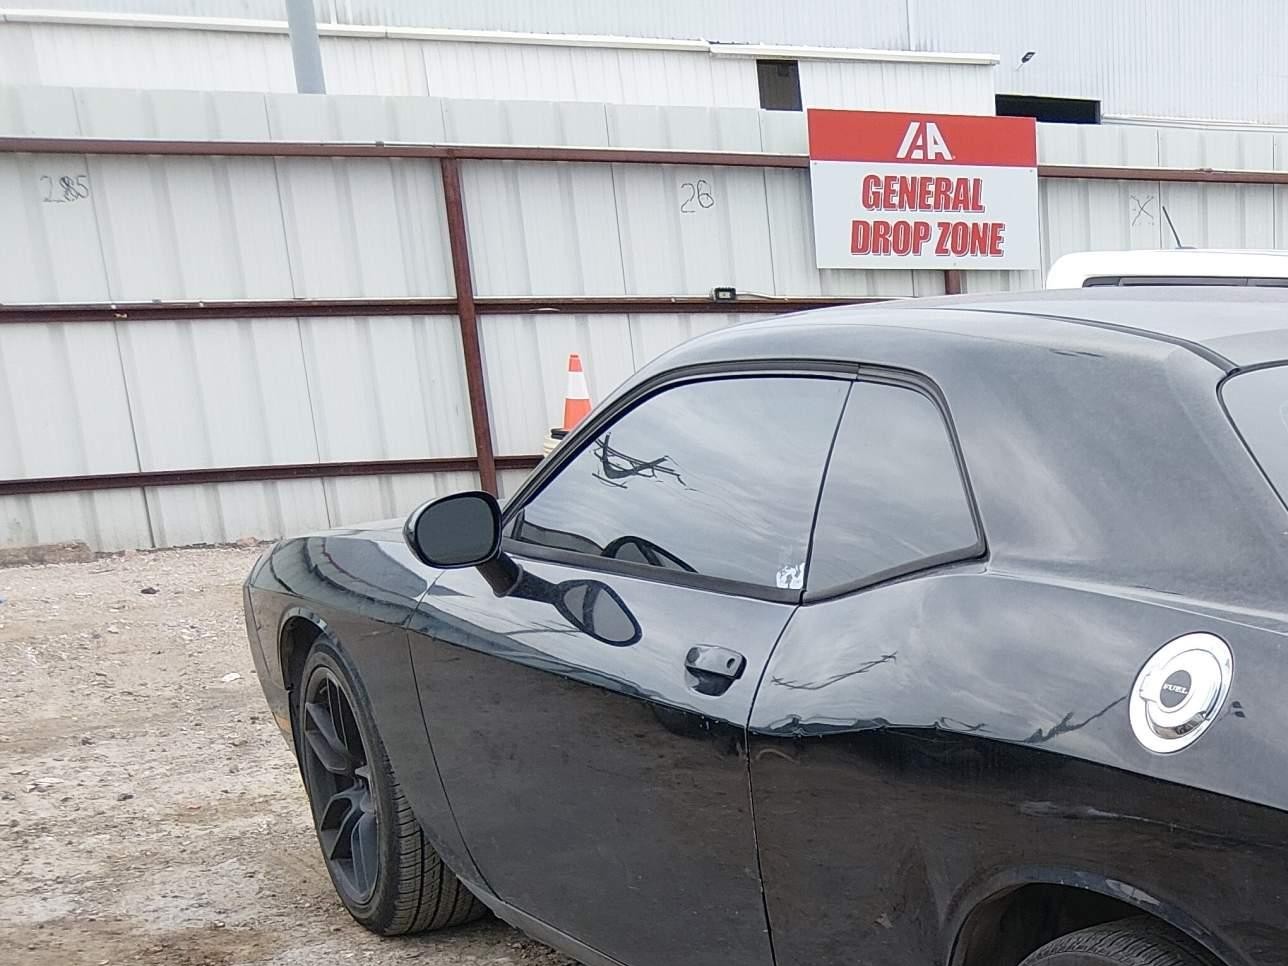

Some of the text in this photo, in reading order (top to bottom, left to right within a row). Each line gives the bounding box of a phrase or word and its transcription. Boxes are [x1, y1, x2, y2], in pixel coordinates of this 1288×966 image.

[680, 179, 714, 213] 26
[862, 174, 985, 213] GENERAL
[850, 220, 1005, 257] DROP ZONE
[1163, 682, 1188, 695] FUEL
